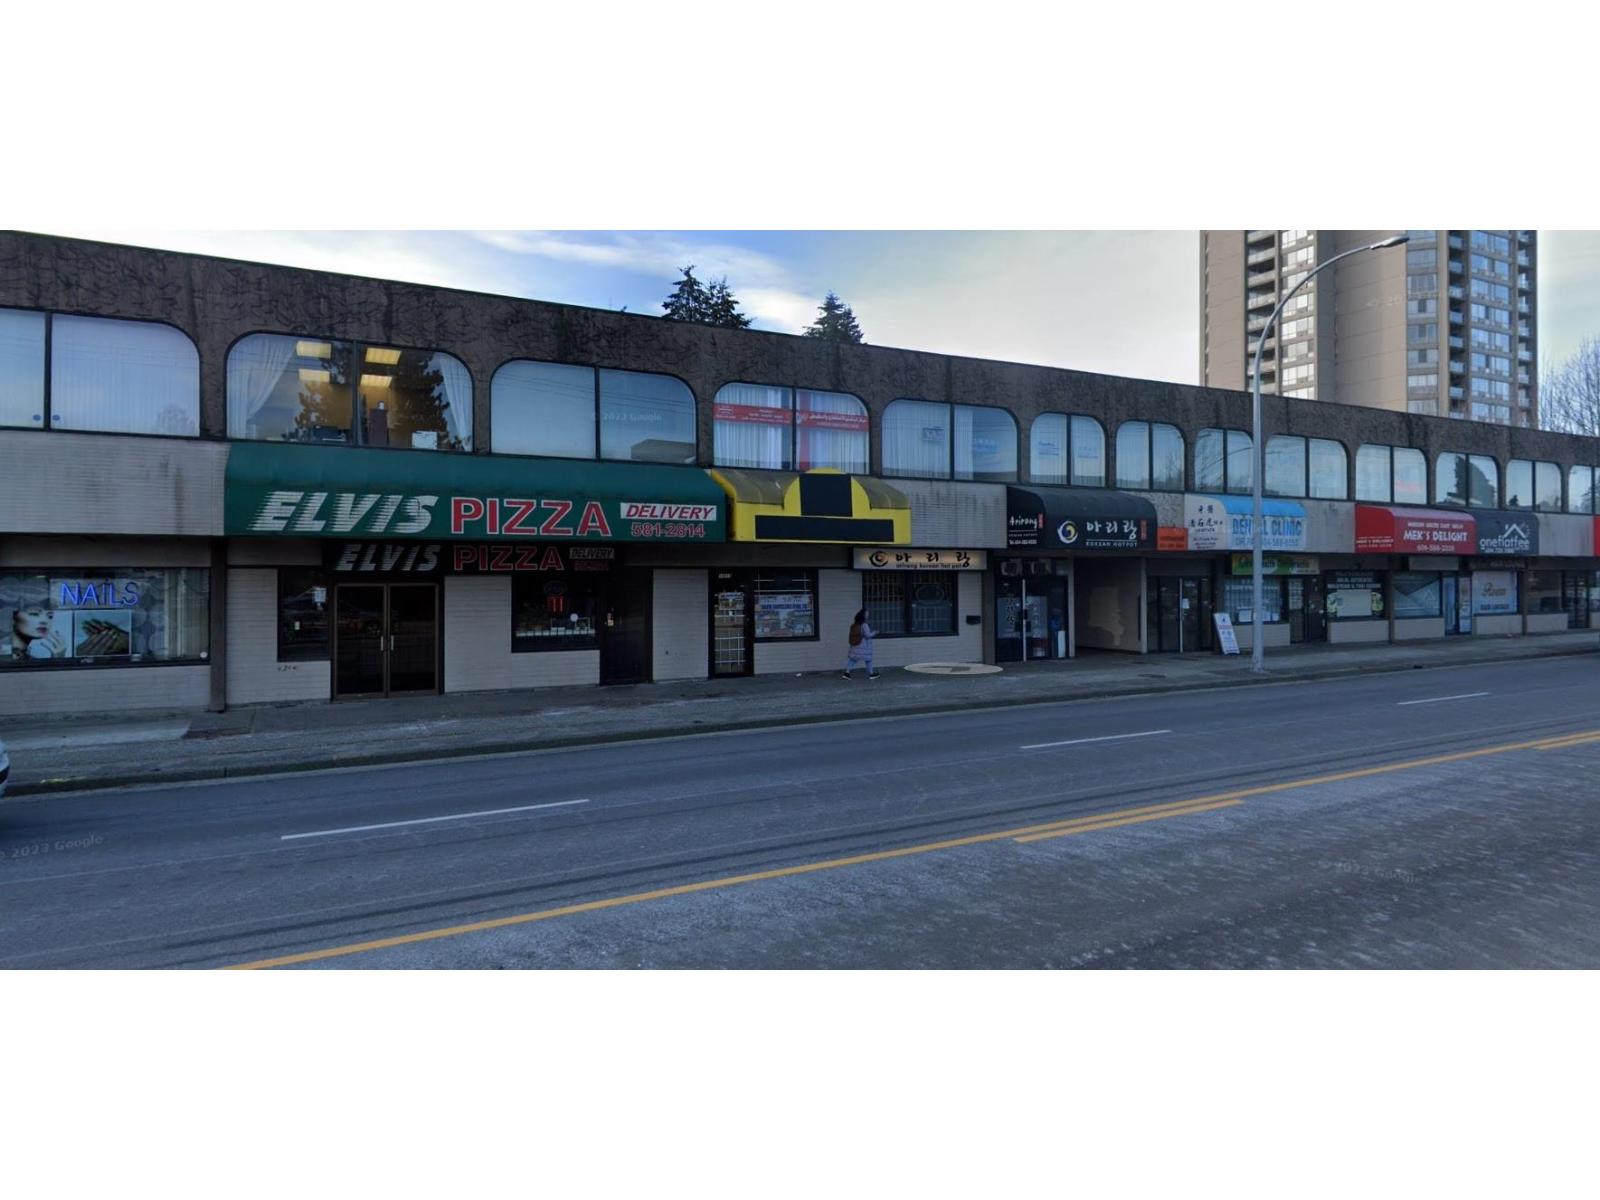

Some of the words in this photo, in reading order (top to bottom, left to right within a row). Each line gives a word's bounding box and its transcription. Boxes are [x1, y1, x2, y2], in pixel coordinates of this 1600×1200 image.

[246, 491, 440, 534] ELVIS
[450, 496, 612, 537] PIZZA
[625, 504, 714, 519] DELIVERY
[631, 522, 705, 537] 581-2814
[1271, 518, 1303, 537] CLINIC
[1432, 531, 1467, 542] DELIGHT
[336, 544, 441, 571] ELVIS
[453, 545, 565, 571] PIZZA
[61, 582, 139, 606] NAILS
